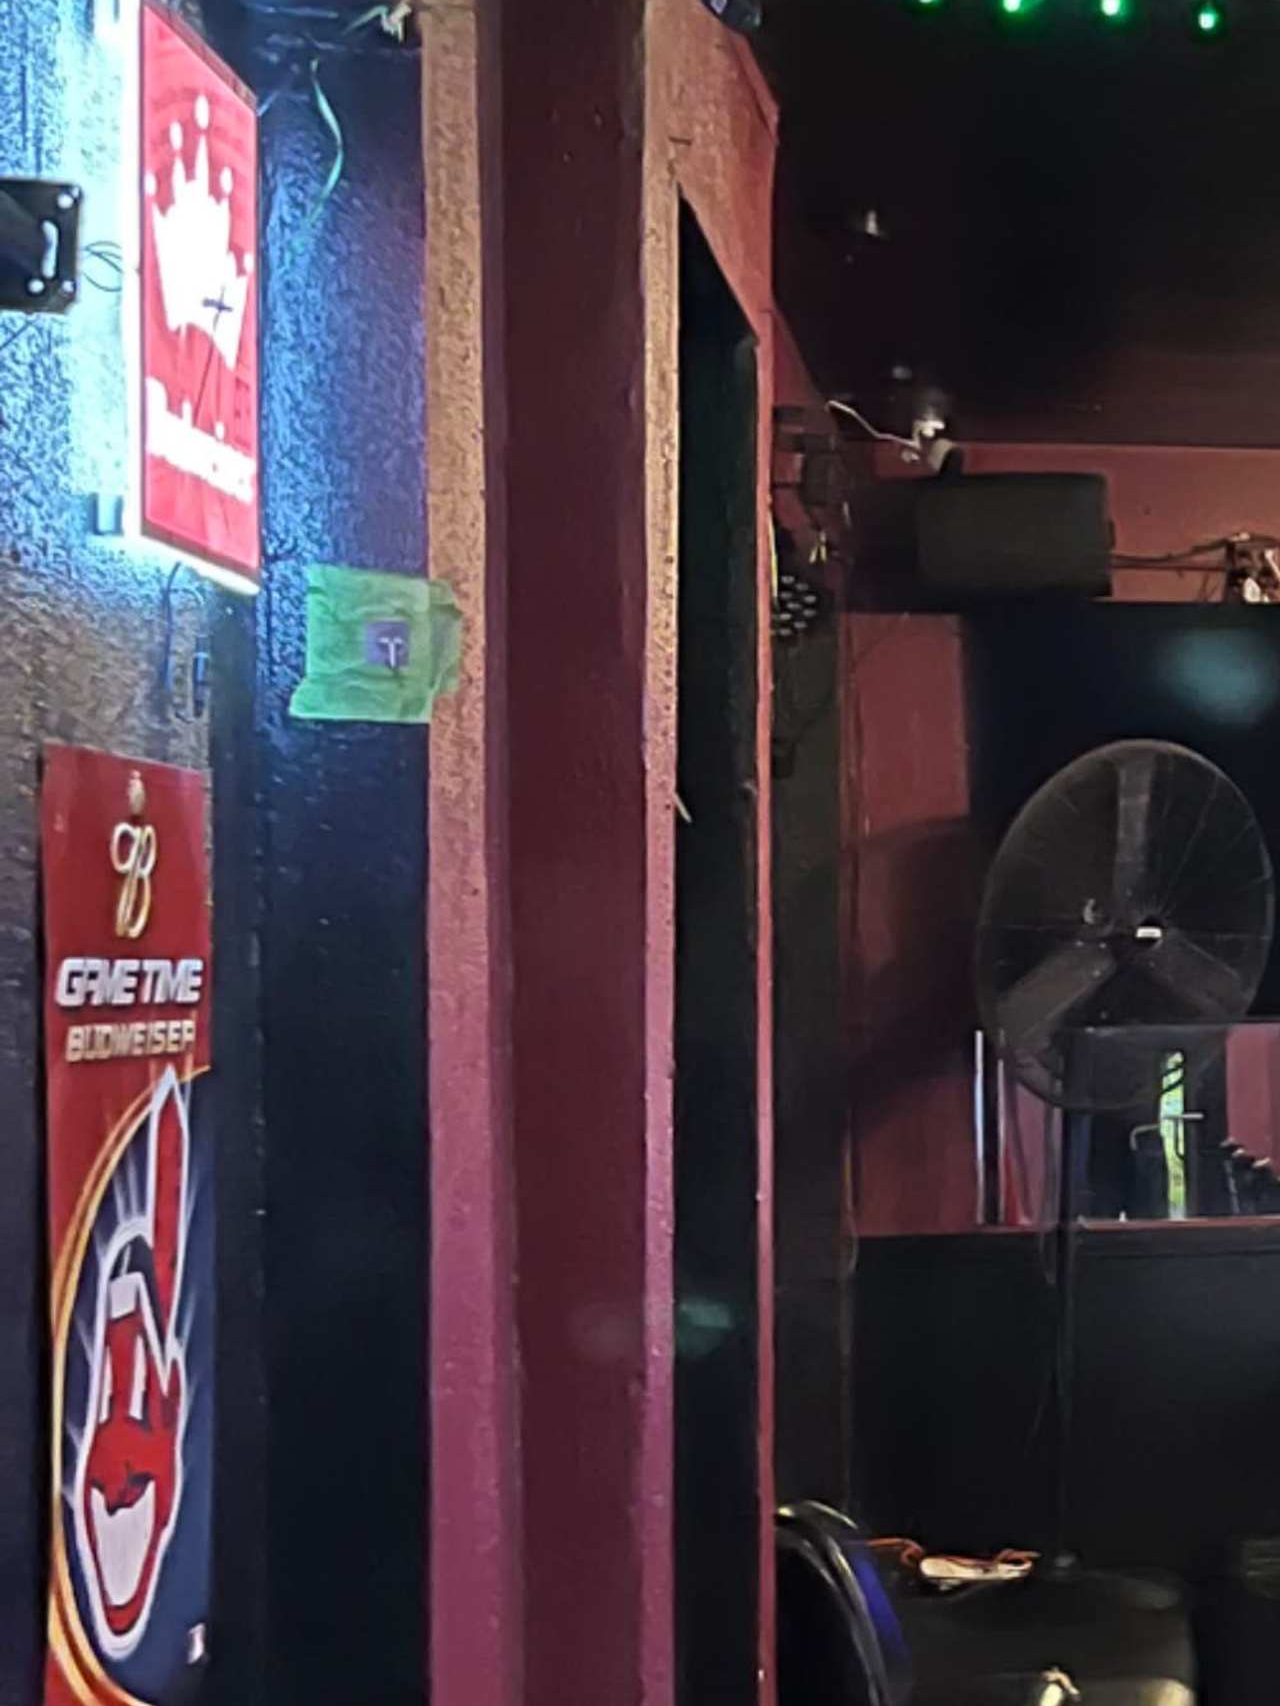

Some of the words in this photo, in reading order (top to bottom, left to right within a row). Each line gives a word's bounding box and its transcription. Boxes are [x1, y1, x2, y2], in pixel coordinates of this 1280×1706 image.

[54, 956, 141, 1007] GAME
[140, 957, 204, 1006] TIME
[65, 1018, 196, 1063] BUDWEISER
